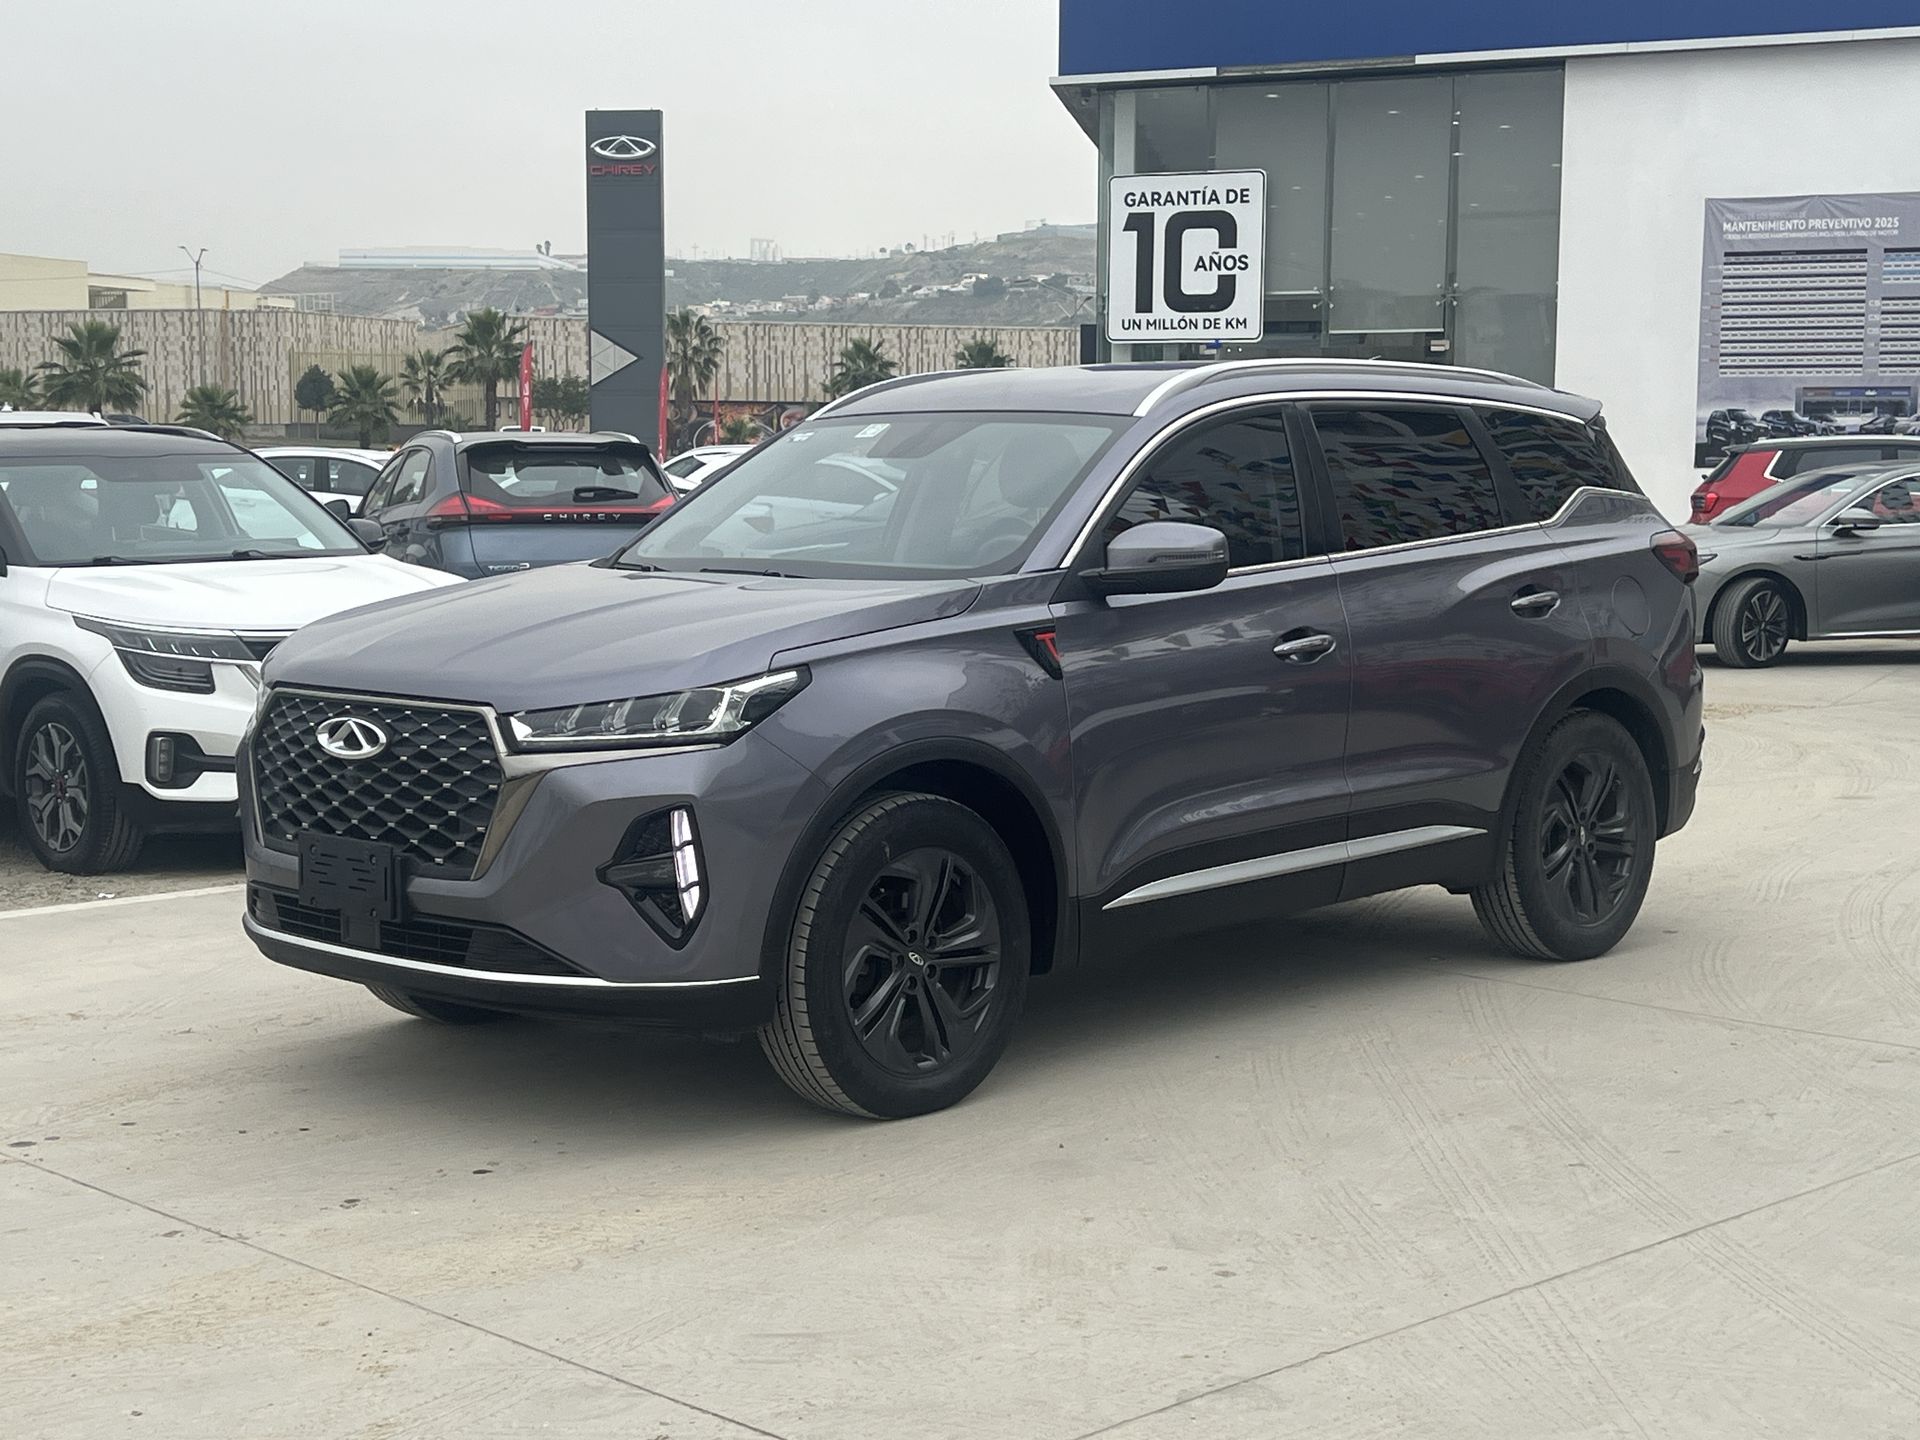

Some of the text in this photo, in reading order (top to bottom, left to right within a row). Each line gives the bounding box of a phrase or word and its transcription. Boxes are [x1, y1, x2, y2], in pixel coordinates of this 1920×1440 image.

[589, 164, 656, 176] CHIREY
[1124, 186, 1250, 207] GARANTÍA DE
[1723, 216, 1900, 232] MANTENIMIENTO PREVENTIVO 2025
[1122, 210, 1237, 313] 10
[1194, 252, 1249, 272] AÑOS
[1121, 316, 1247, 331] UN MILLÓN DE KM
[543, 513, 621, 521] CHIREY
